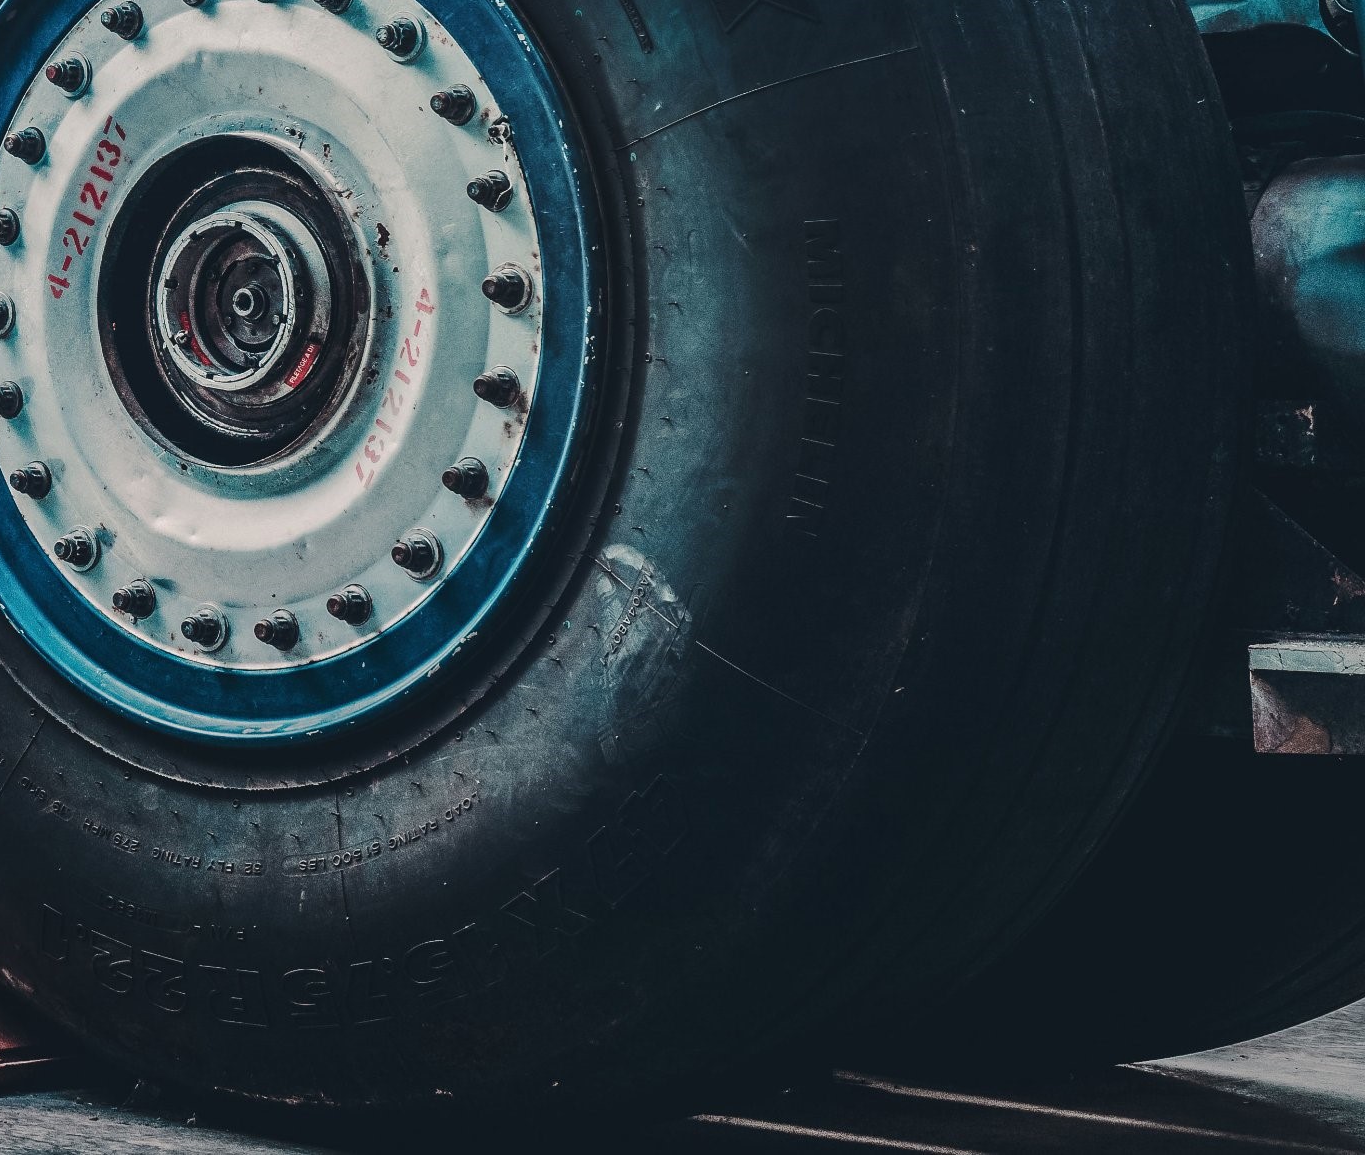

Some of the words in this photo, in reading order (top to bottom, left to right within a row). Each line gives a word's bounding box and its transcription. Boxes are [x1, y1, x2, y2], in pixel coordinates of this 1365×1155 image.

[47, 115, 129, 301] 4-212137
[289, 357, 308, 384] FILETAGE
[355, 286, 437, 488] 4-212137
[80, 815, 111, 844] MPH
[385, 813, 440, 856] RATING
[149, 843, 201, 871] RATING
[205, 858, 235, 875] PLY
[296, 854, 327, 875] LBS
